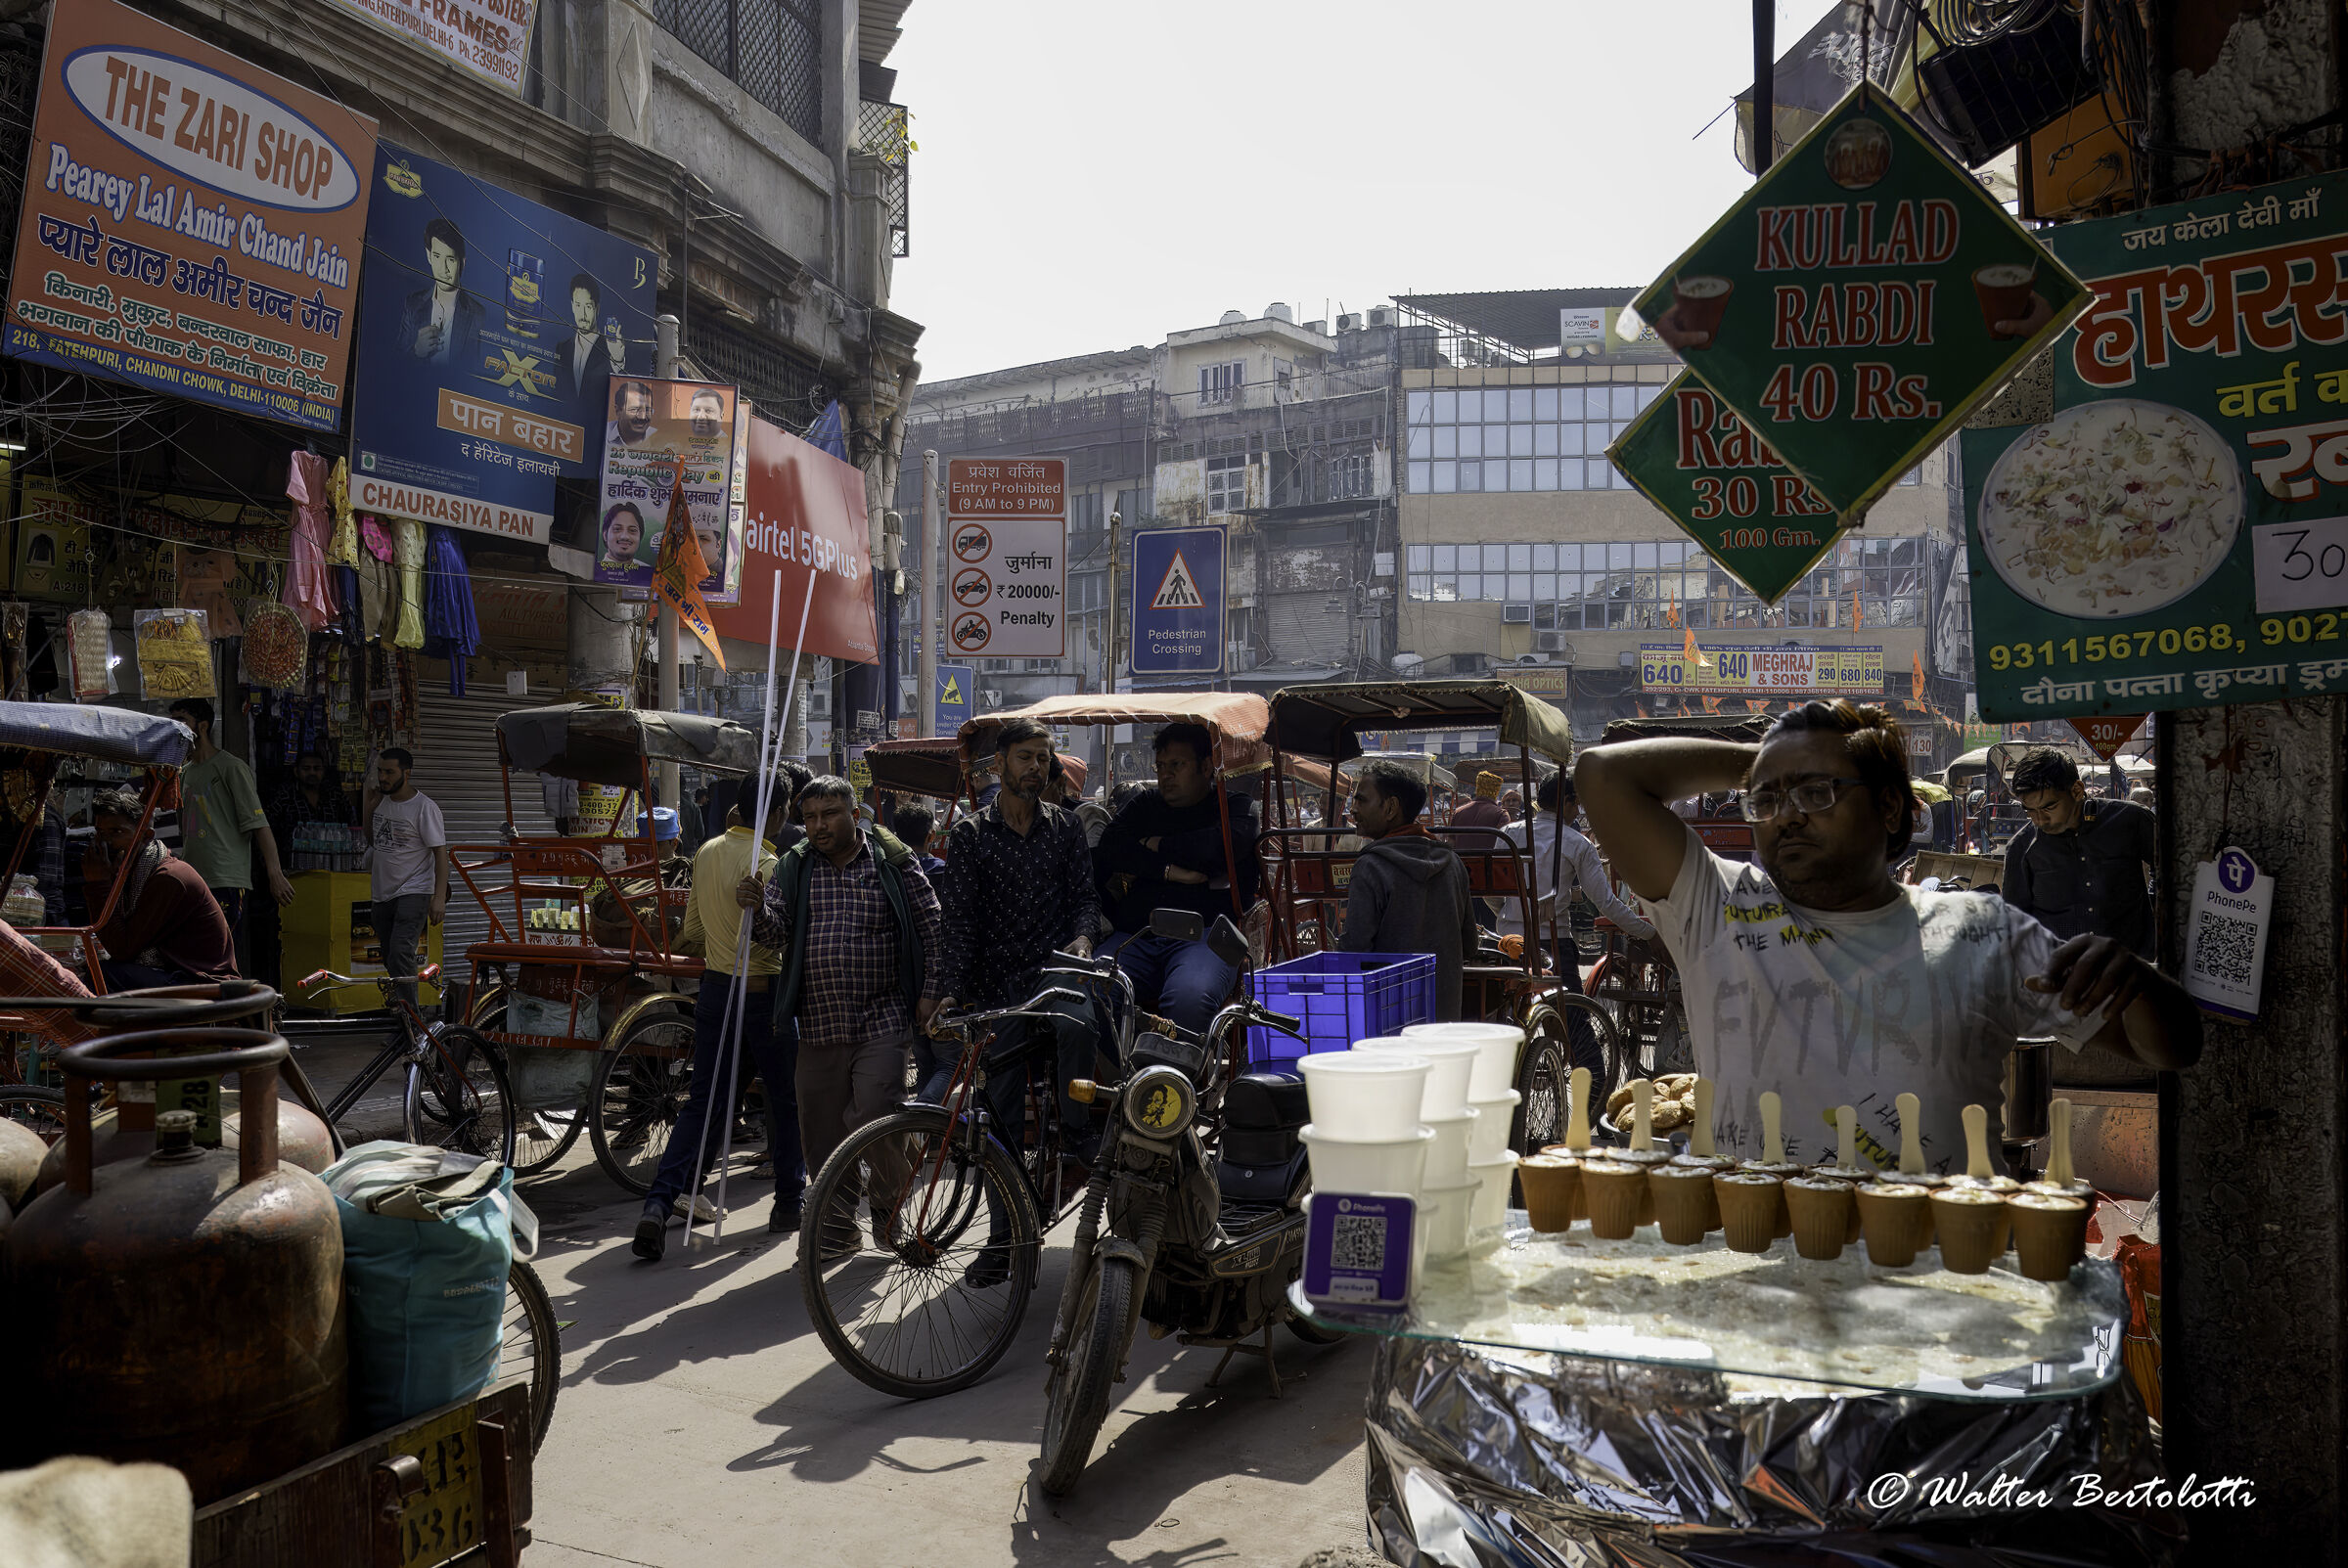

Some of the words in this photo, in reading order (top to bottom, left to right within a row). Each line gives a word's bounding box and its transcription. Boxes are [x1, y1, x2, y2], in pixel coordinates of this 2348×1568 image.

[104, 56, 172, 140] THE
[174, 86, 250, 171] ZARI
[255, 120, 334, 202] SHOP
[46, 142, 135, 223] Pearey
[134, 174, 176, 231] Lal
[176, 190, 239, 250] Amir
[239, 211, 307, 275] Chand
[305, 237, 349, 291] Jain
[2122, 225, 2168, 251] जय
[2173, 212, 2232, 243] केला
[2236, 197, 2282, 231] देवी
[2287, 188, 2324, 220] माँ
[1754, 199, 1960, 272] KULLAD
[37, 212, 106, 268] प्यारे
[106, 235, 173, 289] लाल
[171, 255, 247, 310] अमीर
[247, 279, 297, 326] चन्द
[300, 288, 344, 340] जैन
[44, 270, 117, 315] किनारी,
[299, 347, 329, 371] हार
[1773, 280, 1937, 350] RABDI
[18, 299, 94, 336] भगवान
[93, 318, 124, 343] की
[186, 339, 207, 365] के
[208, 345, 265, 381] निर्माता
[265, 366, 292, 387] एवं
[291, 369, 339, 401] विक्रेता
[12, 329, 41, 353] 218,
[48, 336, 123, 373] FATEHPURI,
[125, 356, 180, 384] CHANDNI
[182, 369, 228, 399] CHOWK,
[301, 399, 336, 426] (INDIA)
[483, 355, 558, 388] FACTOR
[1761, 362, 1838, 423] 40
[1852, 362, 1943, 421] Rs.
[2215, 361, 2302, 421] वर्त
[450, 398, 504, 435] पान
[513, 415, 575, 454] बहार
[461, 443, 471, 458] द
[474, 440, 514, 467] हेरिटेज
[517, 457, 562, 478] इलायची
[608, 460, 673, 479] Republic
[968, 462, 1000, 479] प्रवेश
[1008, 462, 1046, 479] वर्जित
[608, 479, 648, 499] हार्दिक
[952, 482, 990, 496] Entry
[992, 481, 1061, 495] Prohibited
[1692, 476, 1760, 520] 30
[363, 482, 493, 529] CHAURASIYA
[498, 510, 534, 538] PAN
[958, 498, 971, 513] (9
[974, 498, 996, 510] AM
[1000, 499, 1015, 510] to
[1017, 498, 1026, 510] 9
[1028, 498, 1056, 513] PM)
[745, 512, 797, 563] airtel
[1720, 528, 1768, 550] 100
[1774, 526, 1822, 548] Gm.
[1005, 555, 1053, 574] जुर्माना
[1000, 610, 1056, 629] Penalty
[1148, 629, 1207, 641] Pedestrian
[1989, 622, 2247, 671] 9311567068,
[1151, 643, 1202, 657] Crossing
[1644, 663, 1683, 685] 640
[1719, 652, 1748, 679] 640
[1752, 653, 1814, 672] MEGHRAJ
[1818, 668, 1836, 681] 290
[1532, 677, 1565, 690] OPTICS
[1758, 673, 1768, 685] &
[1772, 673, 1809, 686] SONS
[1840, 668, 1861, 682] 680
[1865, 668, 1882, 682] 840
[2090, 724, 2125, 741] 30/-
[1914, 739, 1932, 752] 130
[1734, 931, 1769, 952] THE
